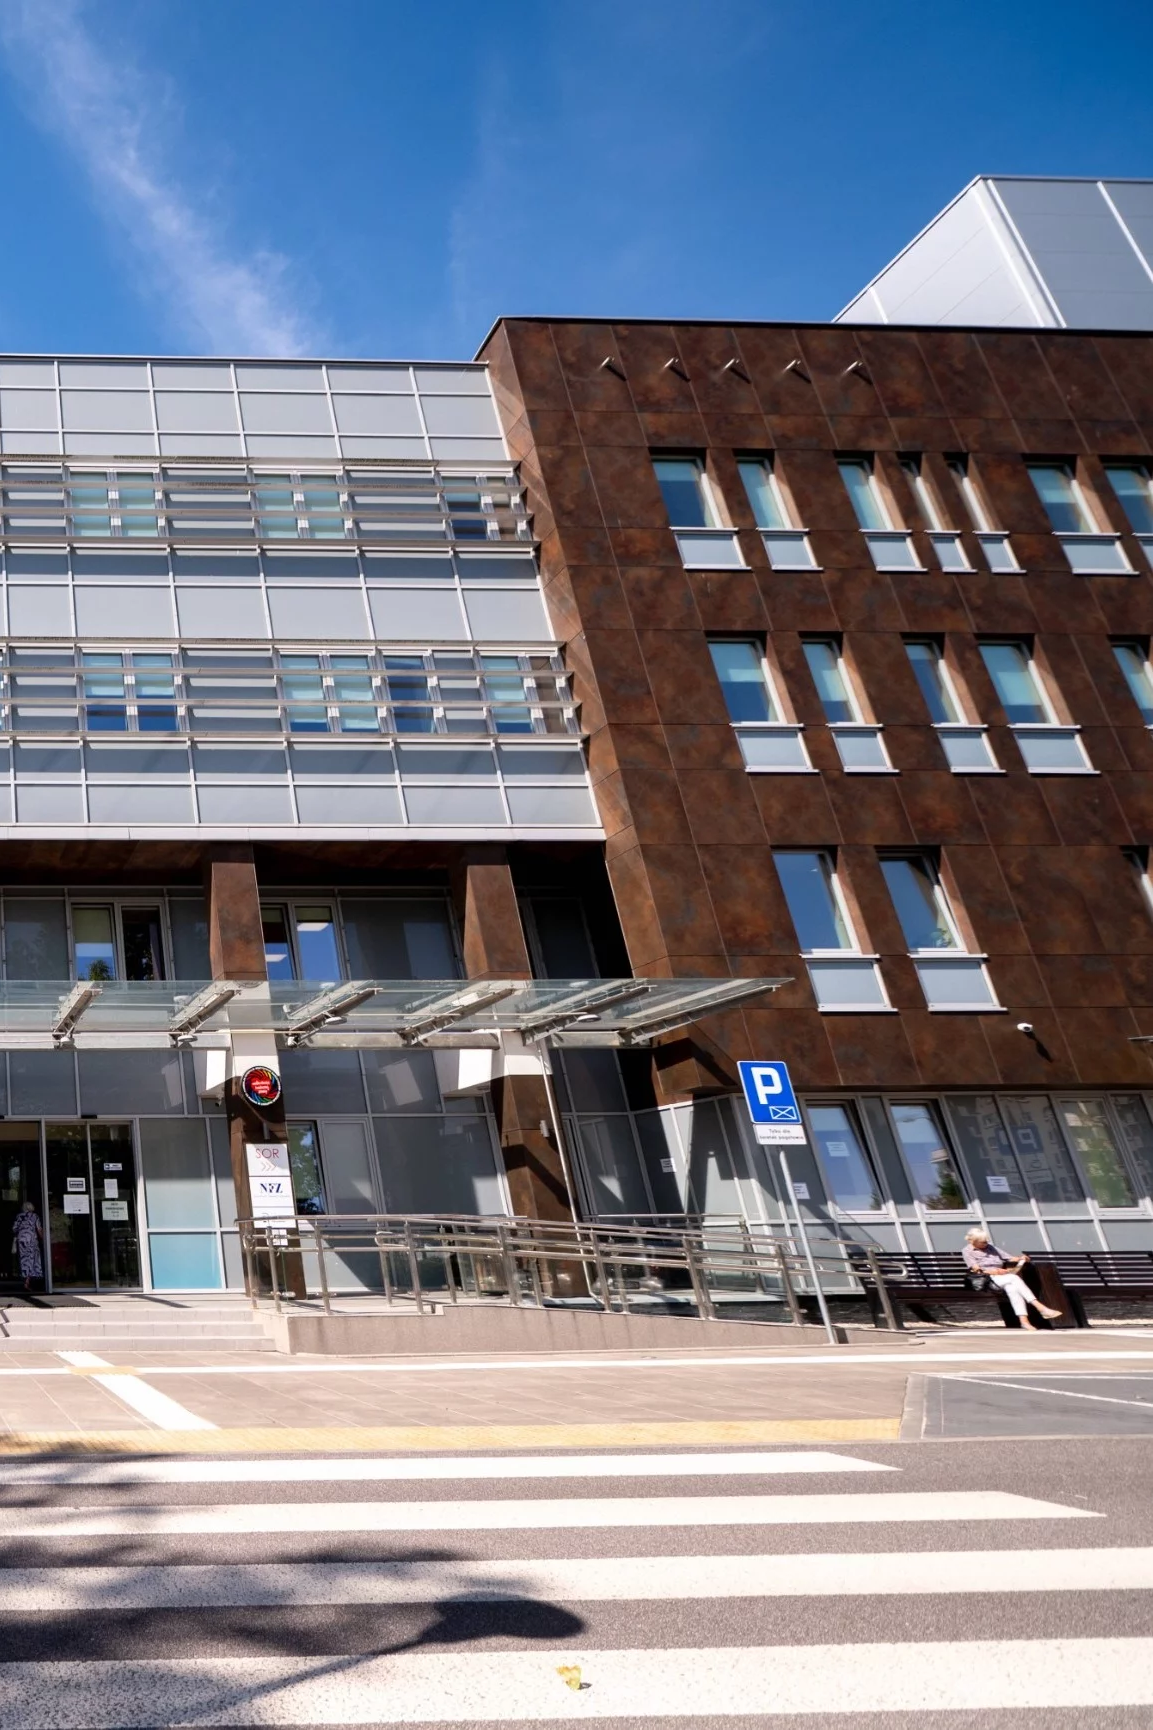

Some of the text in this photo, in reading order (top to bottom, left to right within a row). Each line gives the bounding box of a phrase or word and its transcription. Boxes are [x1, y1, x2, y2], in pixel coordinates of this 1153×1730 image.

[750, 1067, 782, 1105] P
[255, 1148, 280, 1159] SOR
[260, 1183, 283, 1194] NFZ
